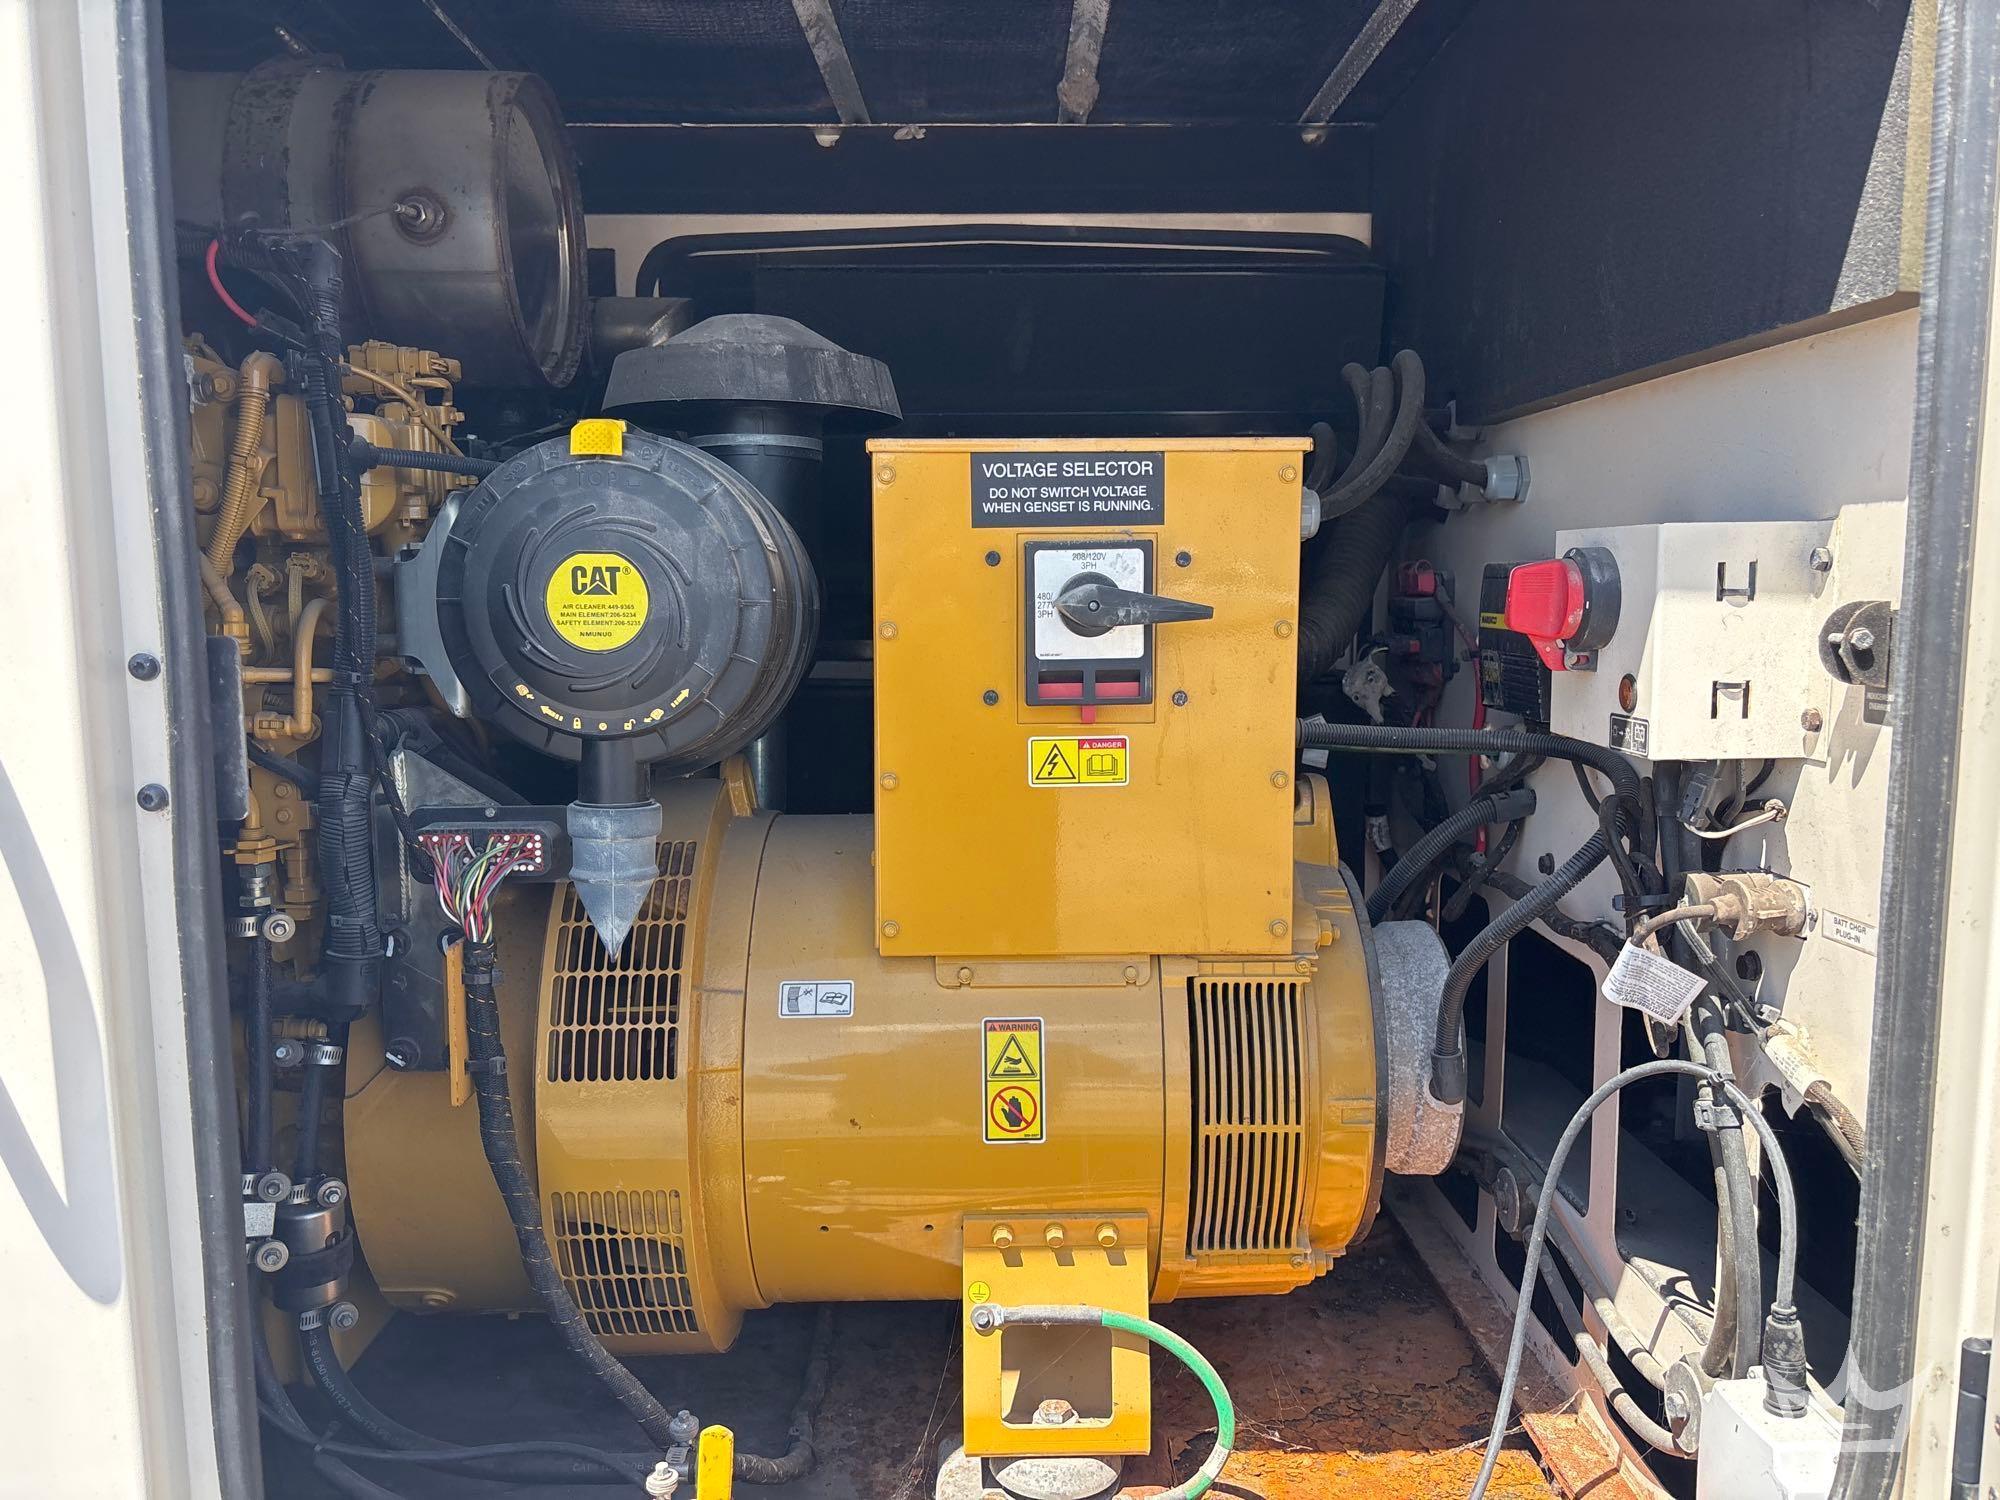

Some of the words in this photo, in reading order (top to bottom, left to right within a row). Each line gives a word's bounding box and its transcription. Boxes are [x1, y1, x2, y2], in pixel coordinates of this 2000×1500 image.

[982, 463, 1058, 478] VOLTAGE
[1062, 461, 1153, 477] SELECTOR
[989, 487, 1008, 499] DO
[1011, 487, 1037, 499] NOT
[1040, 486, 1090, 498] SWITCH
[1092, 485, 1147, 497] VOLTAGE
[982, 502, 1021, 513] WHEN
[1024, 501, 1075, 513] GENSET
[1079, 501, 1090, 512] IS
[1093, 500, 1154, 512] RUNNING.
[1072, 553, 1107, 561] 208/120V
[1081, 562, 1097, 570] 3PH
[1833, 916, 1849, 928] BATT
[1849, 922, 1867, 935] CHGR
[1835, 928, 1861, 944] PLUG-IN
[998, 1024, 1038, 1032] WARNING
